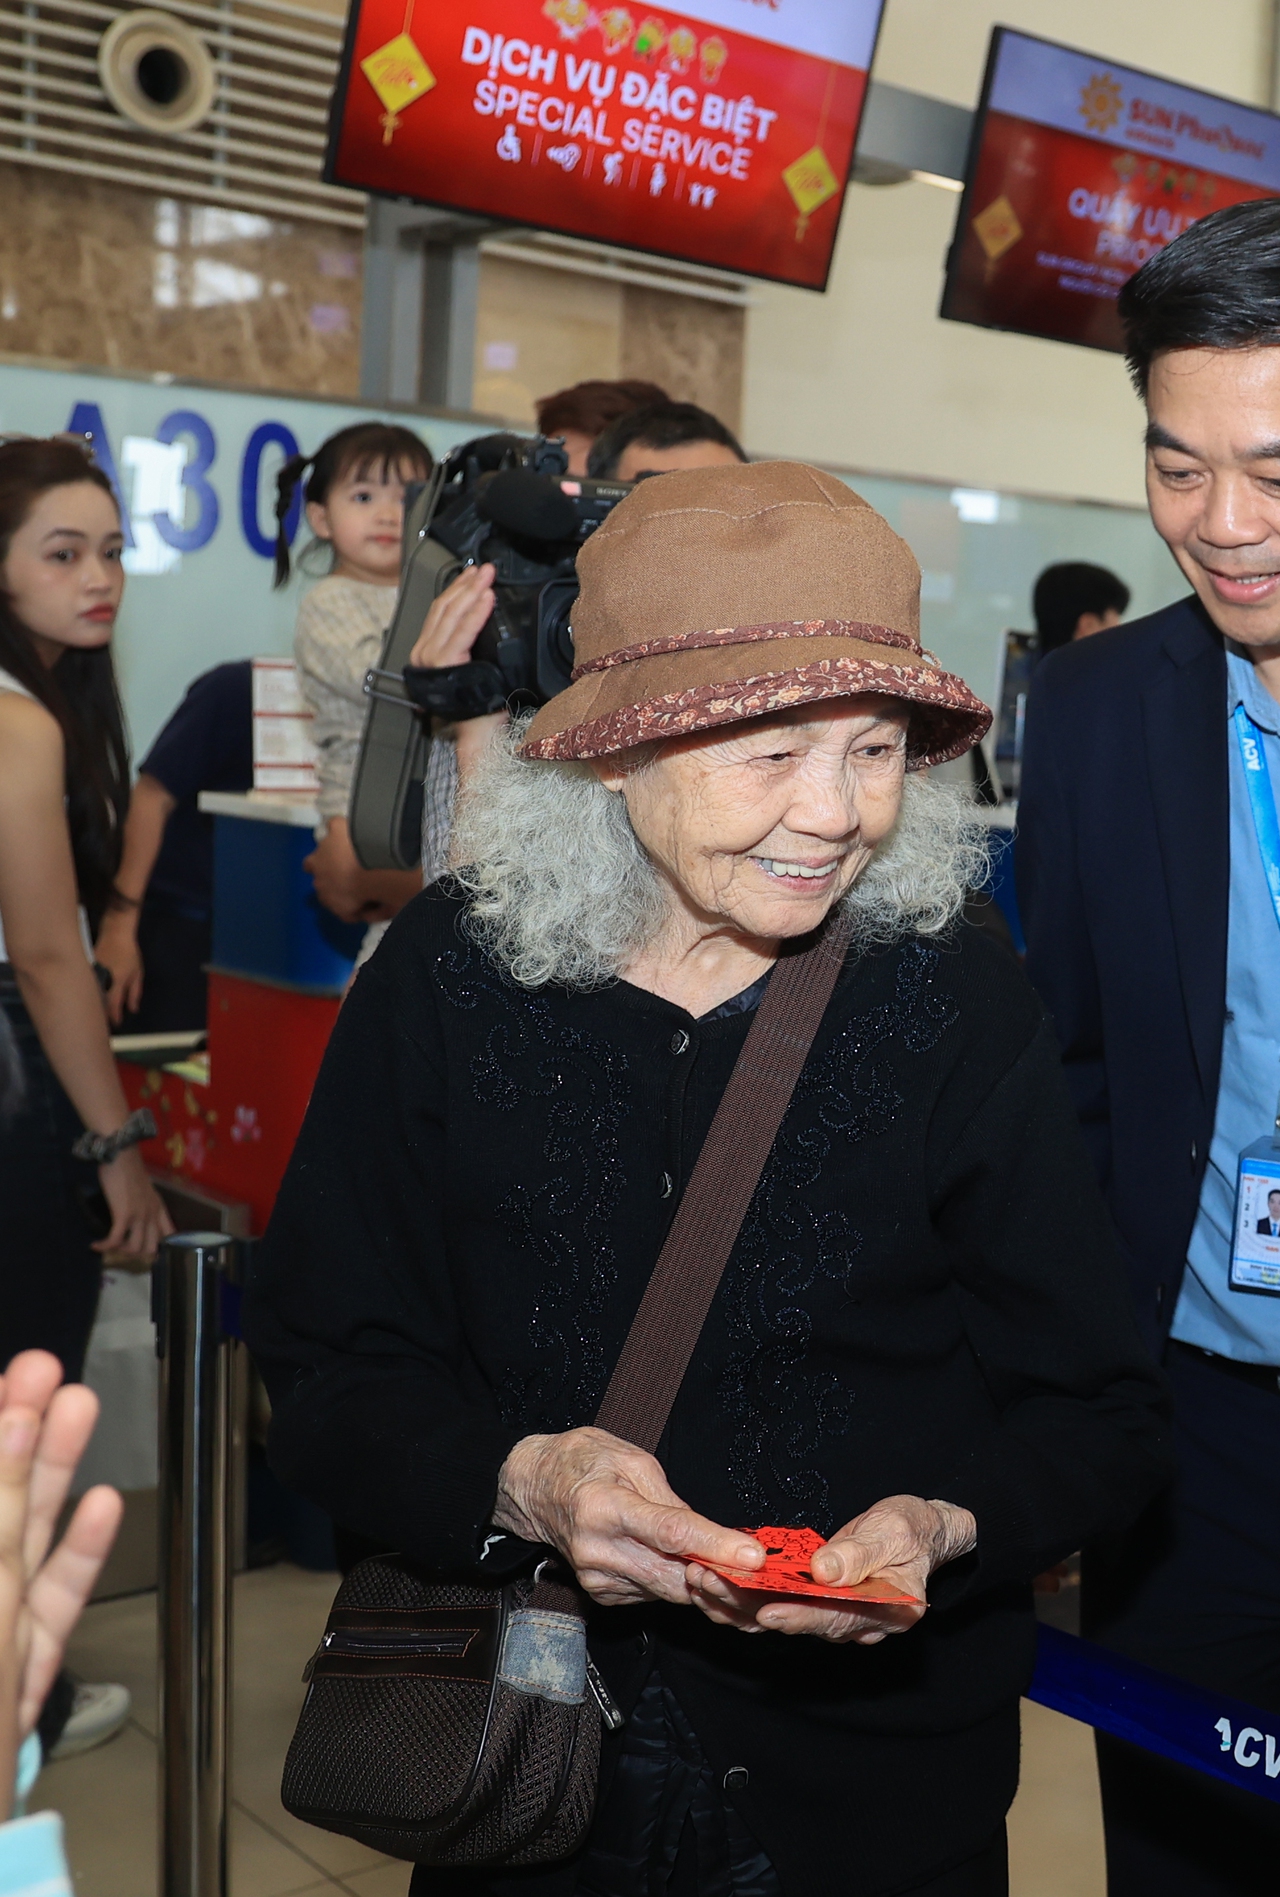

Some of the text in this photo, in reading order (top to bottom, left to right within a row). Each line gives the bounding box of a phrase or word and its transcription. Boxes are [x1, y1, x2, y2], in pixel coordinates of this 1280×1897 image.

[461, 26, 559, 84] DỊCH
[565, 53, 617, 107] VỤ
[620, 71, 698, 122] ĐẶC
[700, 93, 777, 144] BIỆT
[473, 79, 614, 147] SPECIAL
[622, 117, 753, 180] SERVICE
[1242, 737, 1261, 771] ACV
